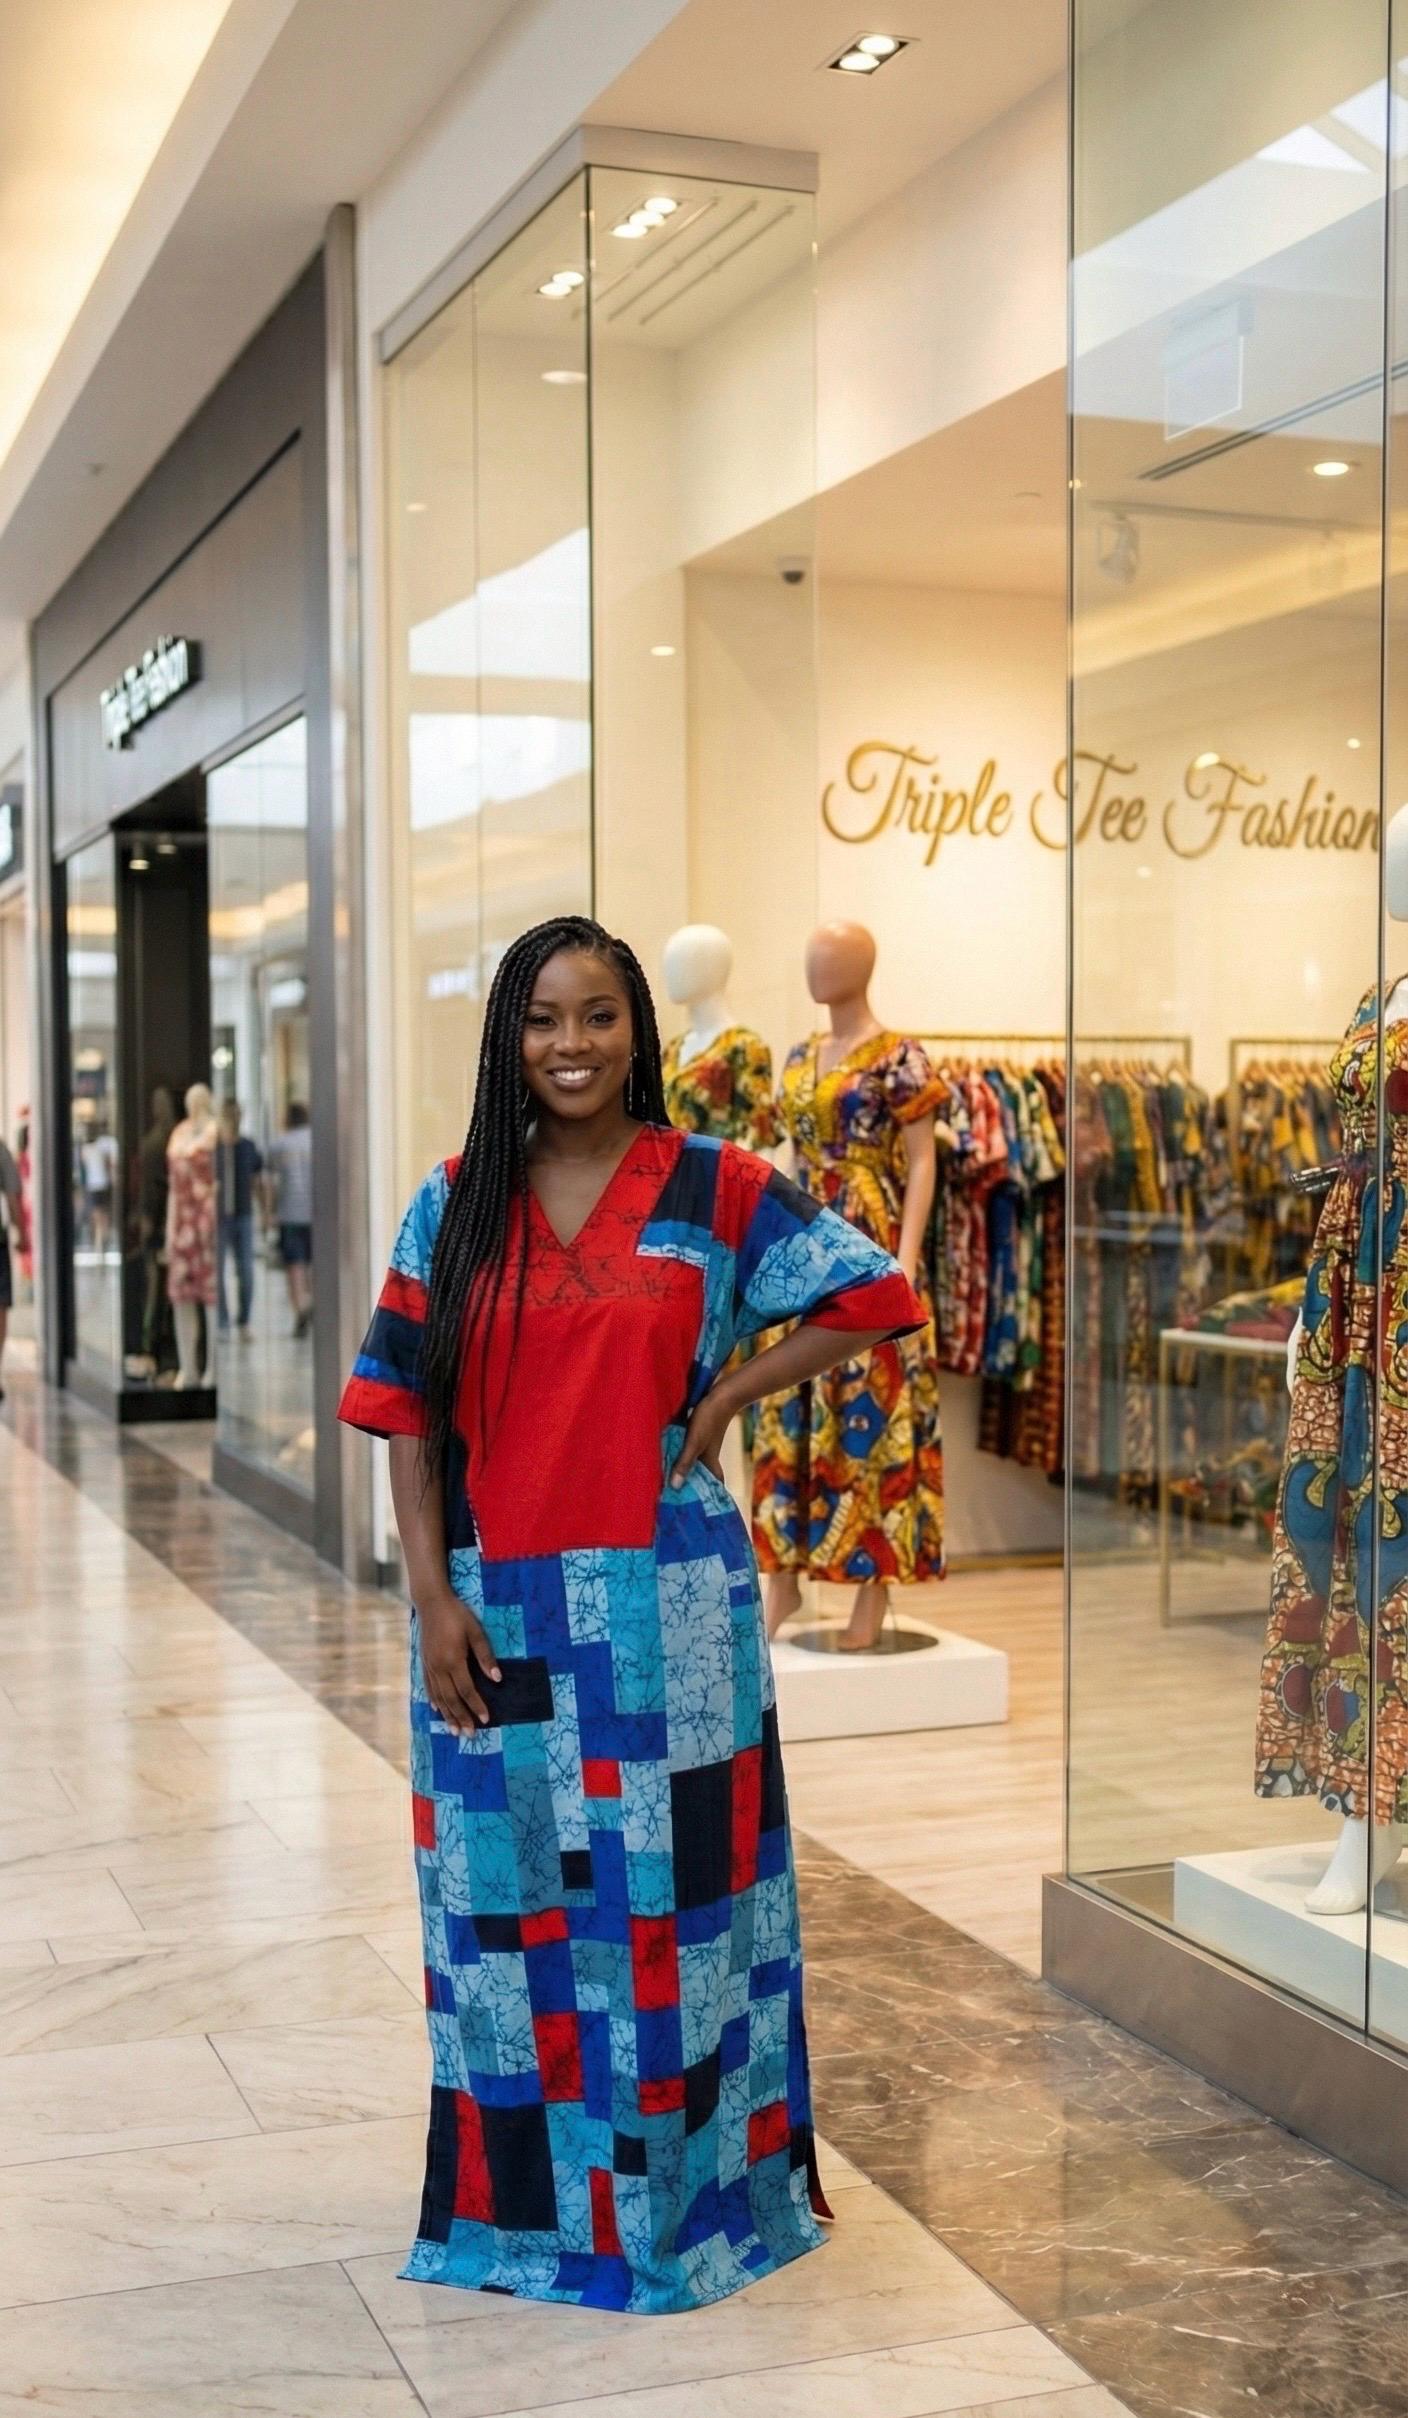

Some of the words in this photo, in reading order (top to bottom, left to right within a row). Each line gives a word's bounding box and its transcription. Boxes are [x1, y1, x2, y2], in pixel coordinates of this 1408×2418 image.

[821, 741, 1014, 866] Triple
[1030, 751, 1147, 850] Tee
[1163, 760, 1380, 858] Fashion
